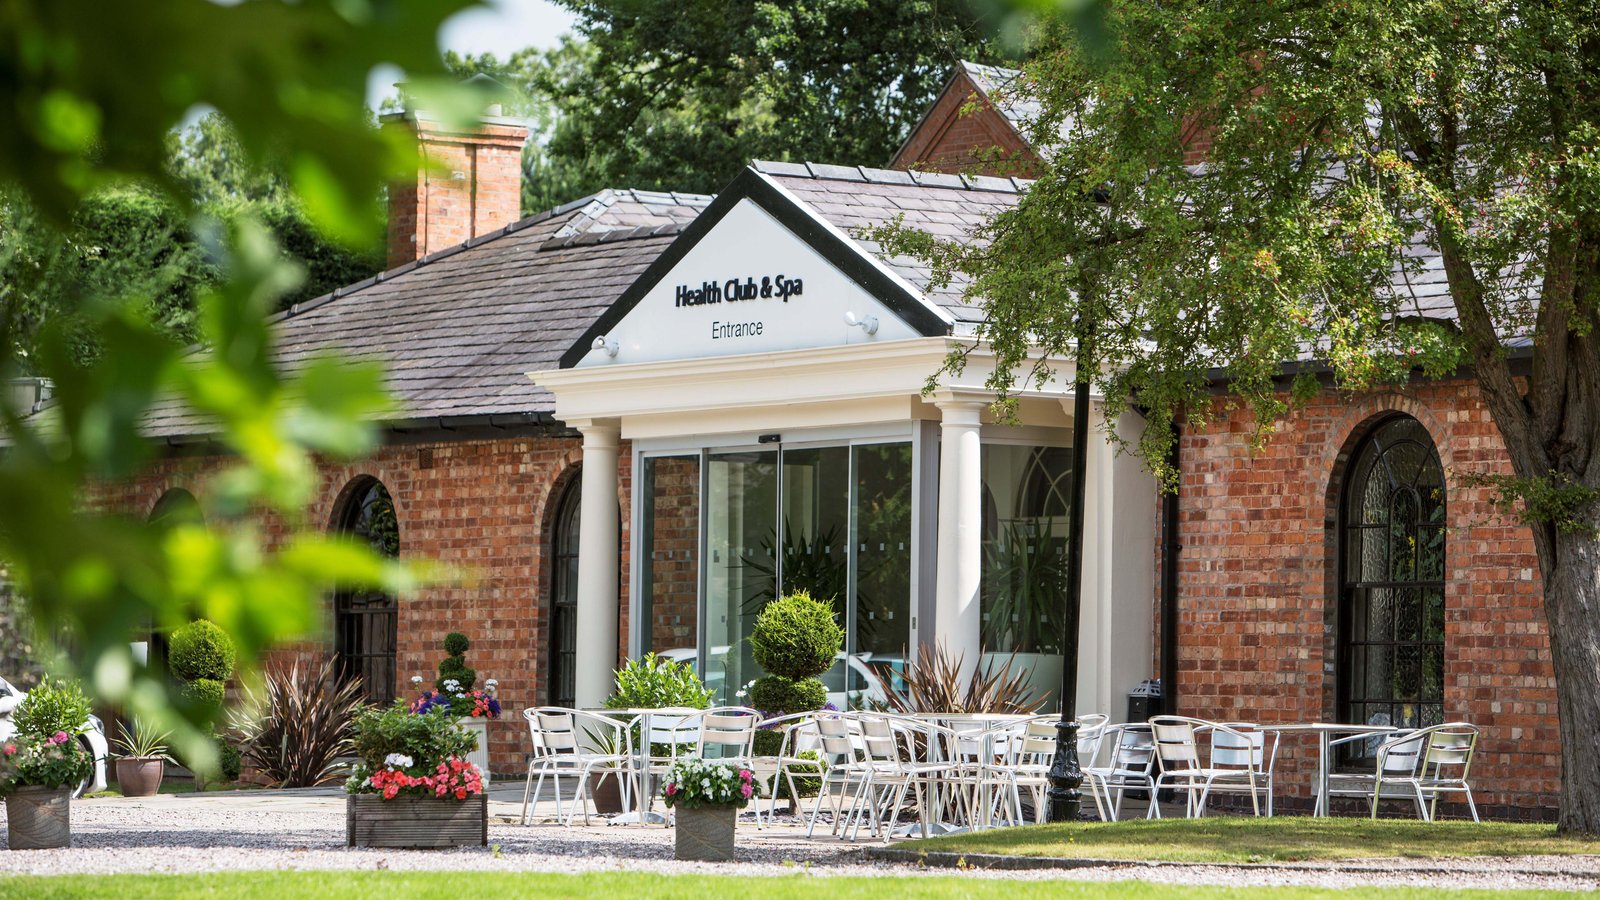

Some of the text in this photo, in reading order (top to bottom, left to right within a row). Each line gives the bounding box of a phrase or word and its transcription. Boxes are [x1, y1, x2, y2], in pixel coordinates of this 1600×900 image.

[676, 275, 803, 307] Health Club & Spa
[712, 321, 763, 339] Entrance
